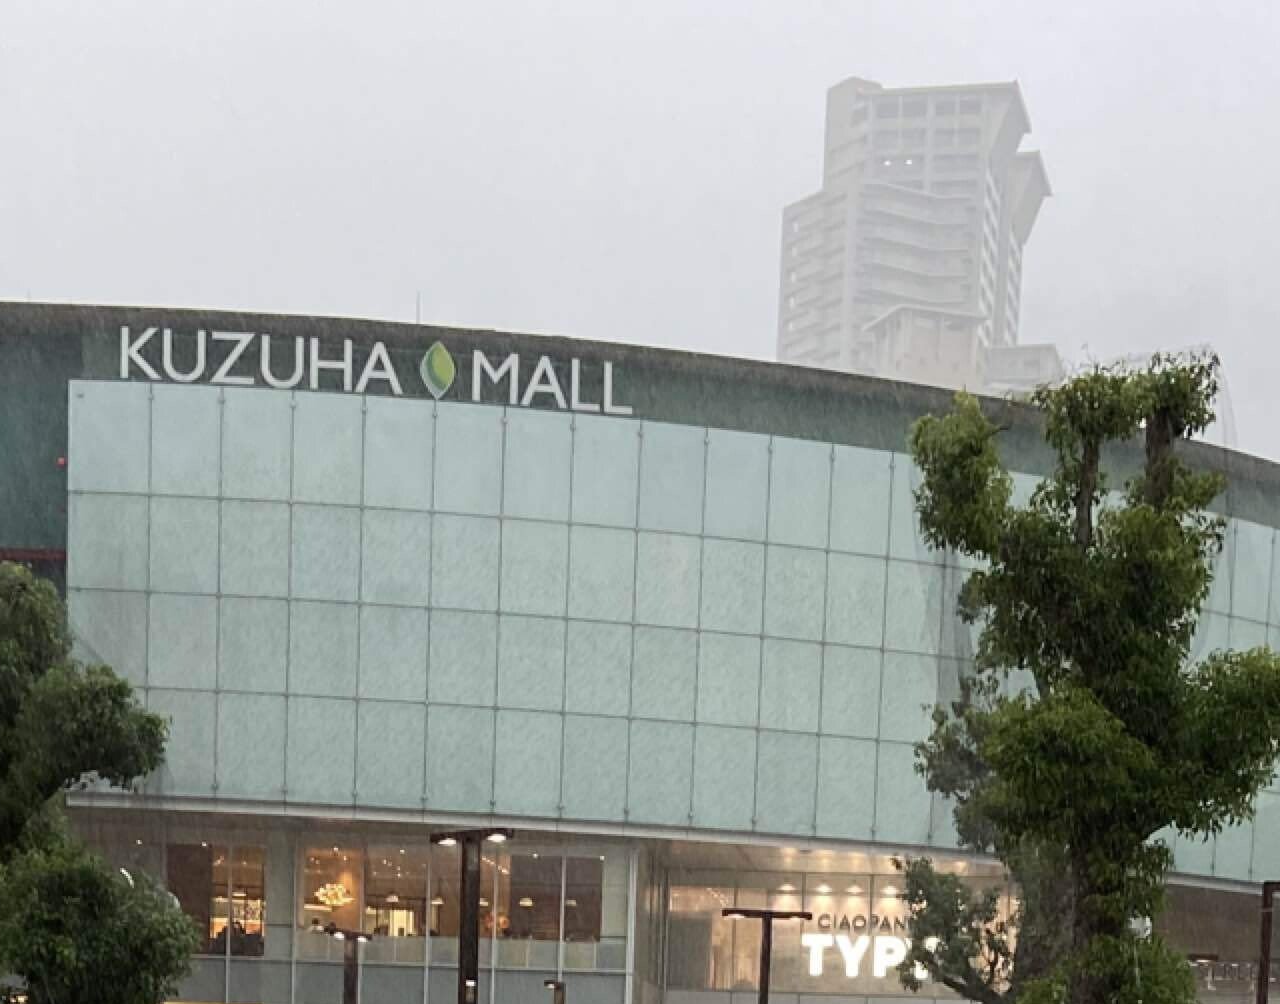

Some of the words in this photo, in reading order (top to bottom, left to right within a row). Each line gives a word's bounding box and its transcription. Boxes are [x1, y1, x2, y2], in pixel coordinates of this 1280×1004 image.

[119, 325, 403, 395] KUZUHA
[471, 348, 634, 415] MALL
[817, 913, 908, 930] CIAOPAN
